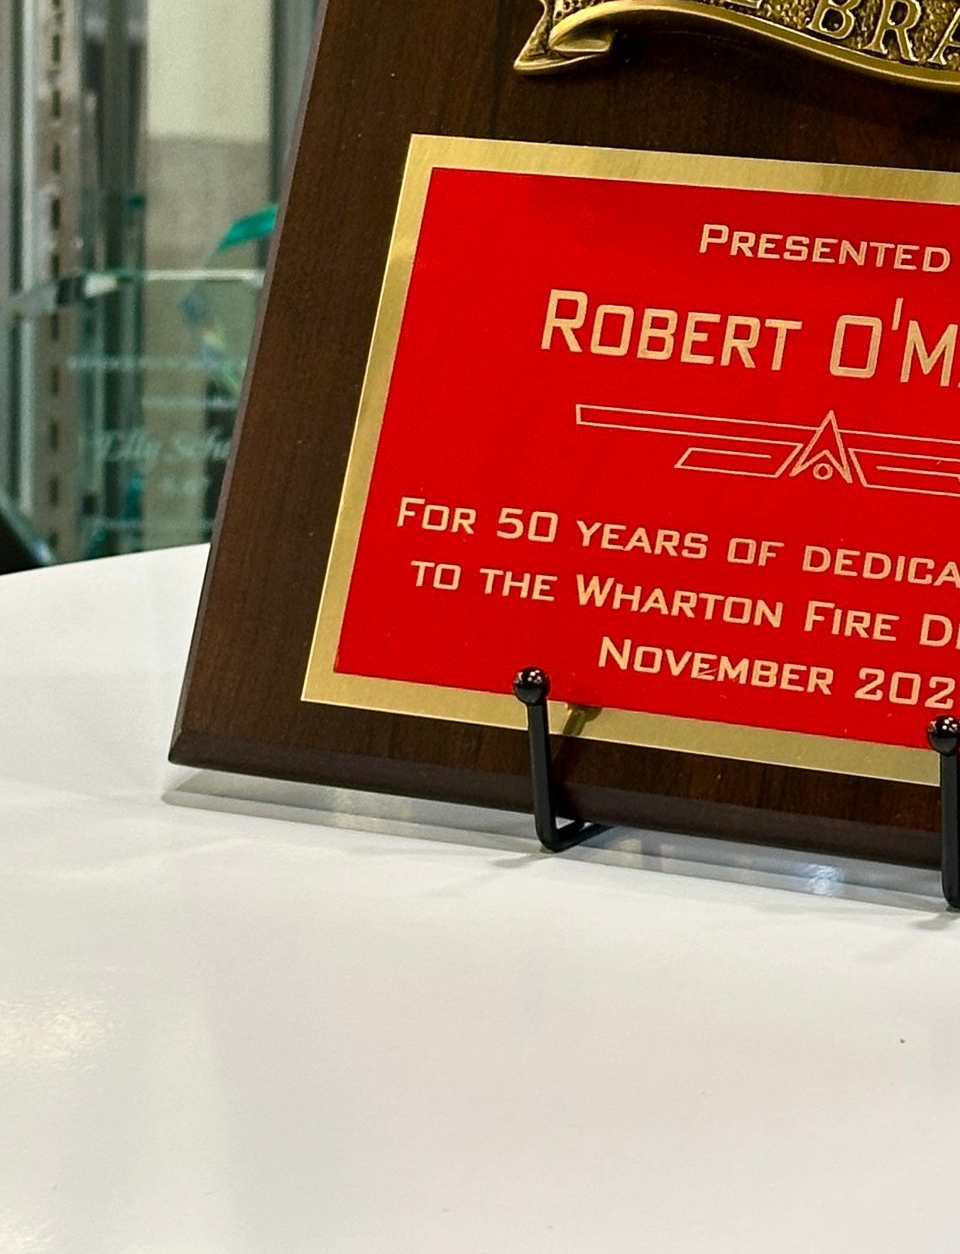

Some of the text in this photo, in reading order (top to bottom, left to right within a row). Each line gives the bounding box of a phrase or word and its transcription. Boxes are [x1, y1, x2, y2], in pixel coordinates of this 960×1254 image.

[699, 223, 951, 273] PRESENTED
[541, 289, 803, 372] ROBERT
[396, 497, 477, 535] FOR
[497, 507, 559, 543] 50
[576, 521, 709, 560] YEARS
[726, 537, 785, 567] OF
[411, 560, 462, 591] TO
[480, 568, 558, 602] THE
[576, 574, 784, 628] WHARTON
[804, 600, 900, 642] FIRE
[598, 636, 834, 696] NOVEMBER
